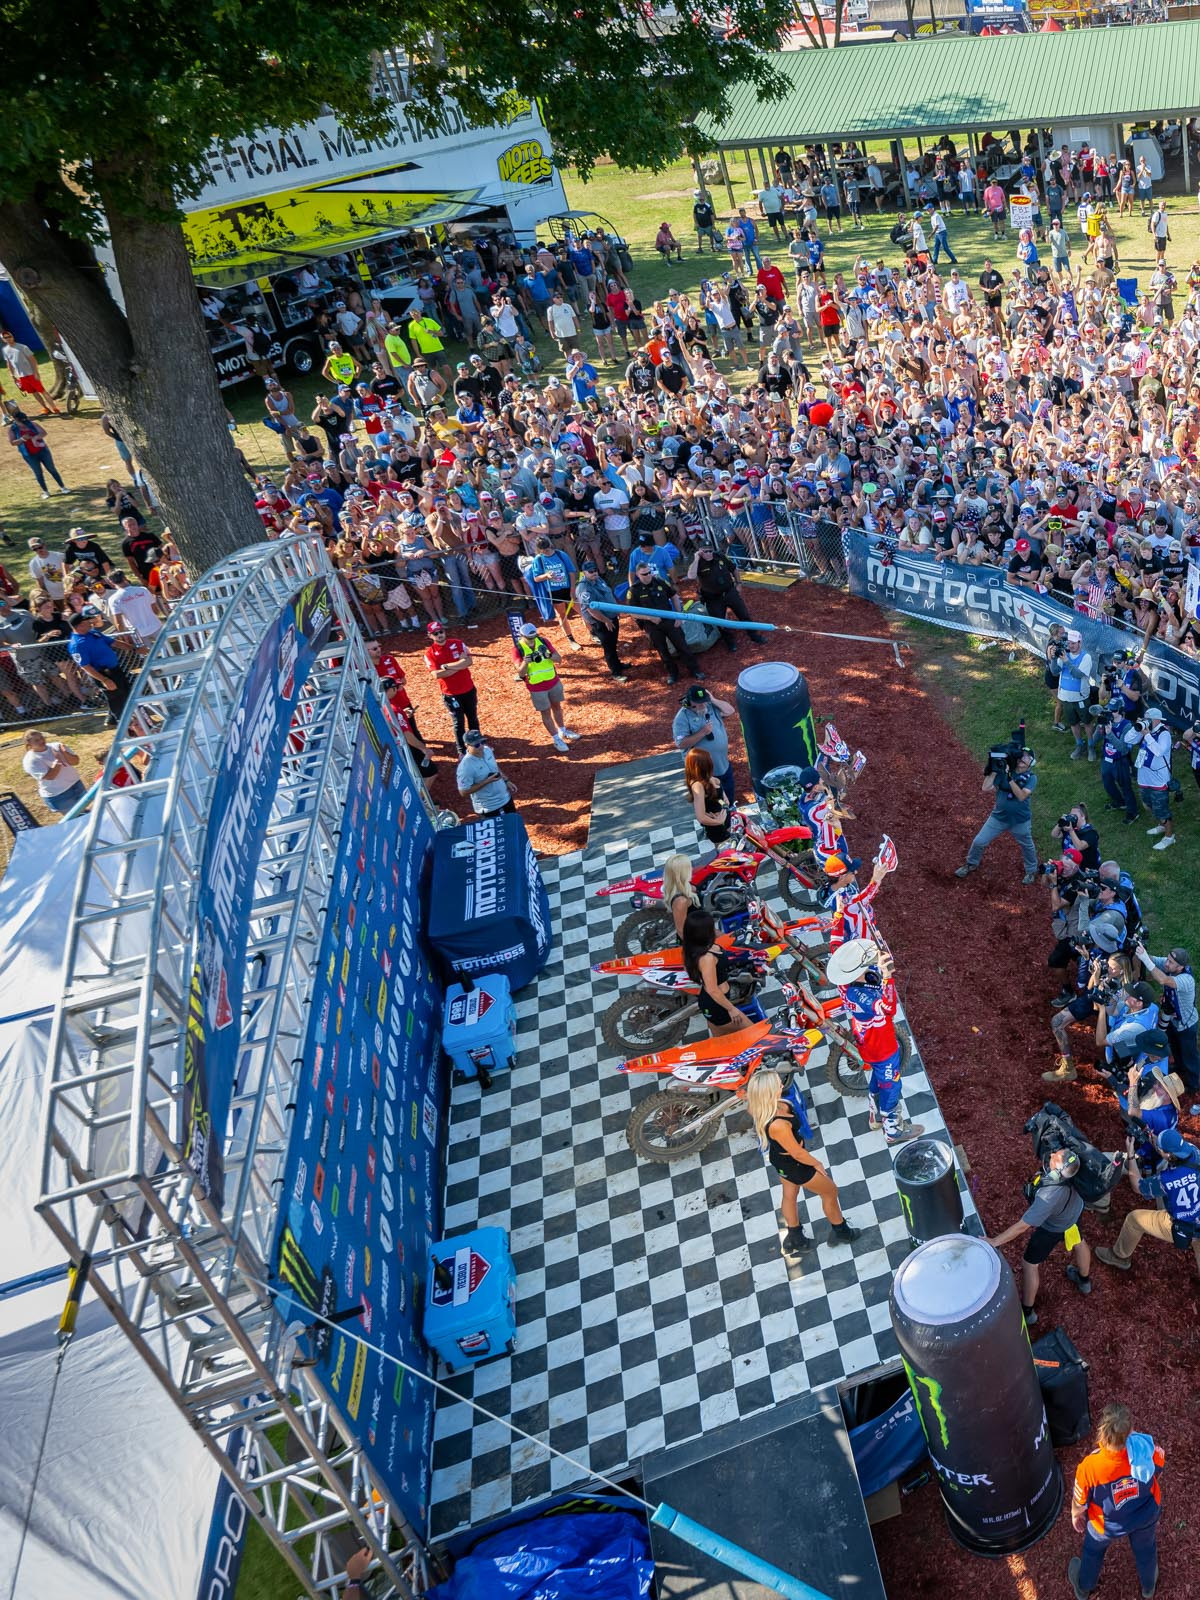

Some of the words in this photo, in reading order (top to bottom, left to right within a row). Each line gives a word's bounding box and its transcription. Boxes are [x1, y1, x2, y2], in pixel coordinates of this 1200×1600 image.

[202, 133, 319, 188] FFICIAL
[500, 140, 544, 179] MOTO
[511, 155, 553, 184] TEES
[866, 556, 1050, 634] MOTOCROS
[466, 858, 475, 884] PRO
[475, 818, 497, 918] MOTOCROSS
[496, 817, 506, 912] CHAMPIONSHIP
[452, 945, 526, 973] MOTOCROSS
[658, 971, 680, 986] 4
[695, 1066, 717, 1084] 7
[1167, 1173, 1197, 1190] PRESS
[1176, 1183, 1200, 1209] 47
[457, 1262, 467, 1290] REDBUD
[371, 1388, 382, 1421] NBC
